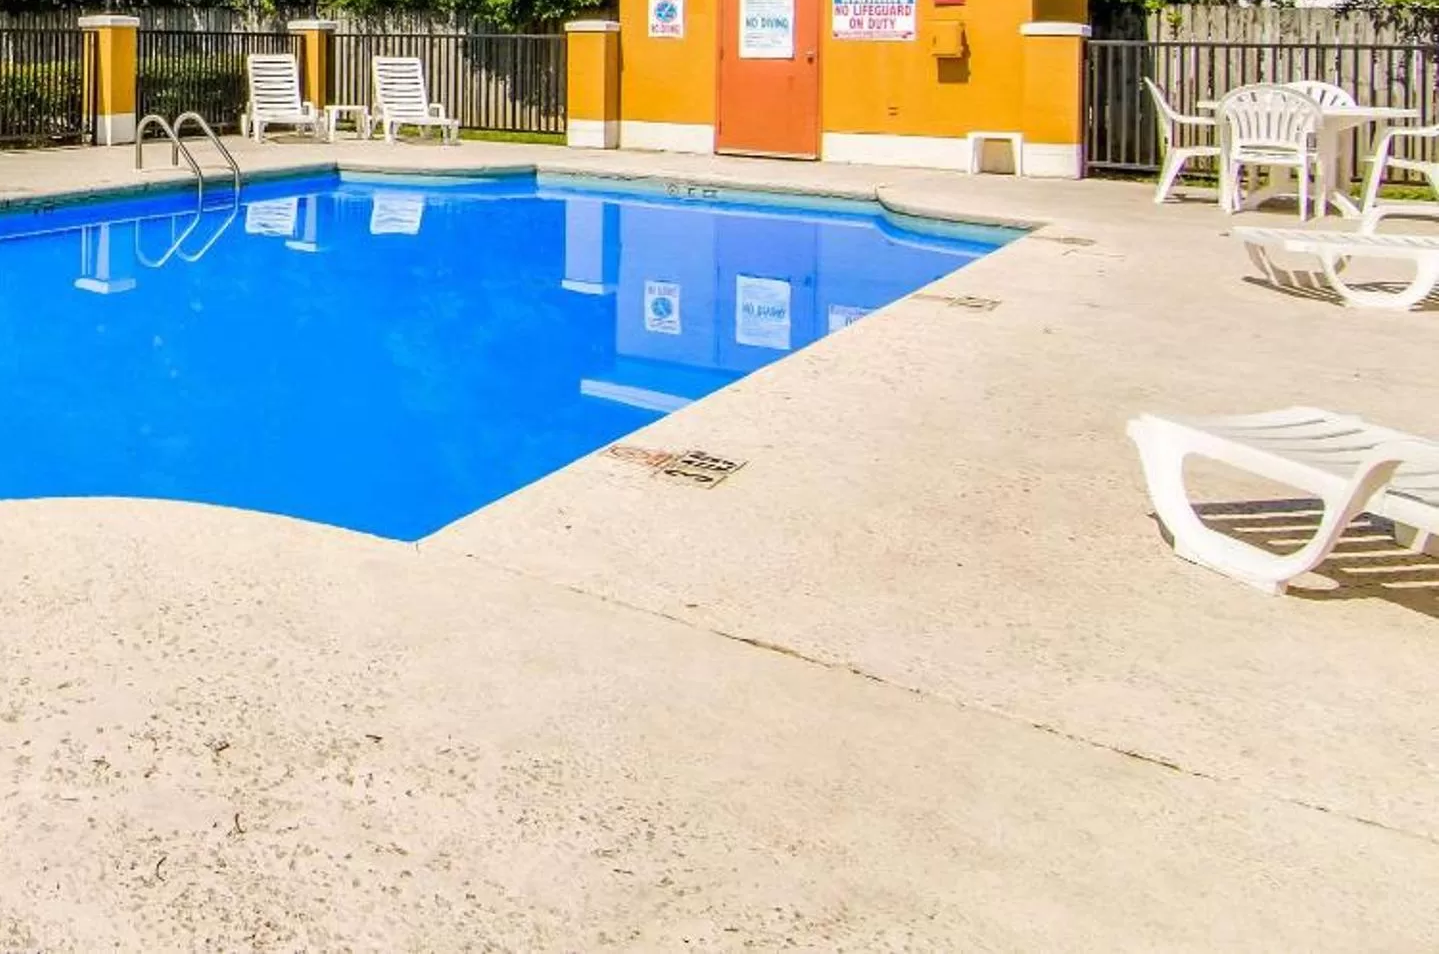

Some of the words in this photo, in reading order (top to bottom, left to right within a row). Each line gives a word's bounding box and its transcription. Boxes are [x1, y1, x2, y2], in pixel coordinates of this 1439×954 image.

[834, 5, 849, 16] NO
[853, 5, 912, 16] LIFEGUARD
[746, 17, 759, 28] NO
[761, 17, 788, 29] DIVING
[849, 18, 863, 29] ON
[868, 18, 897, 29] DUTY
